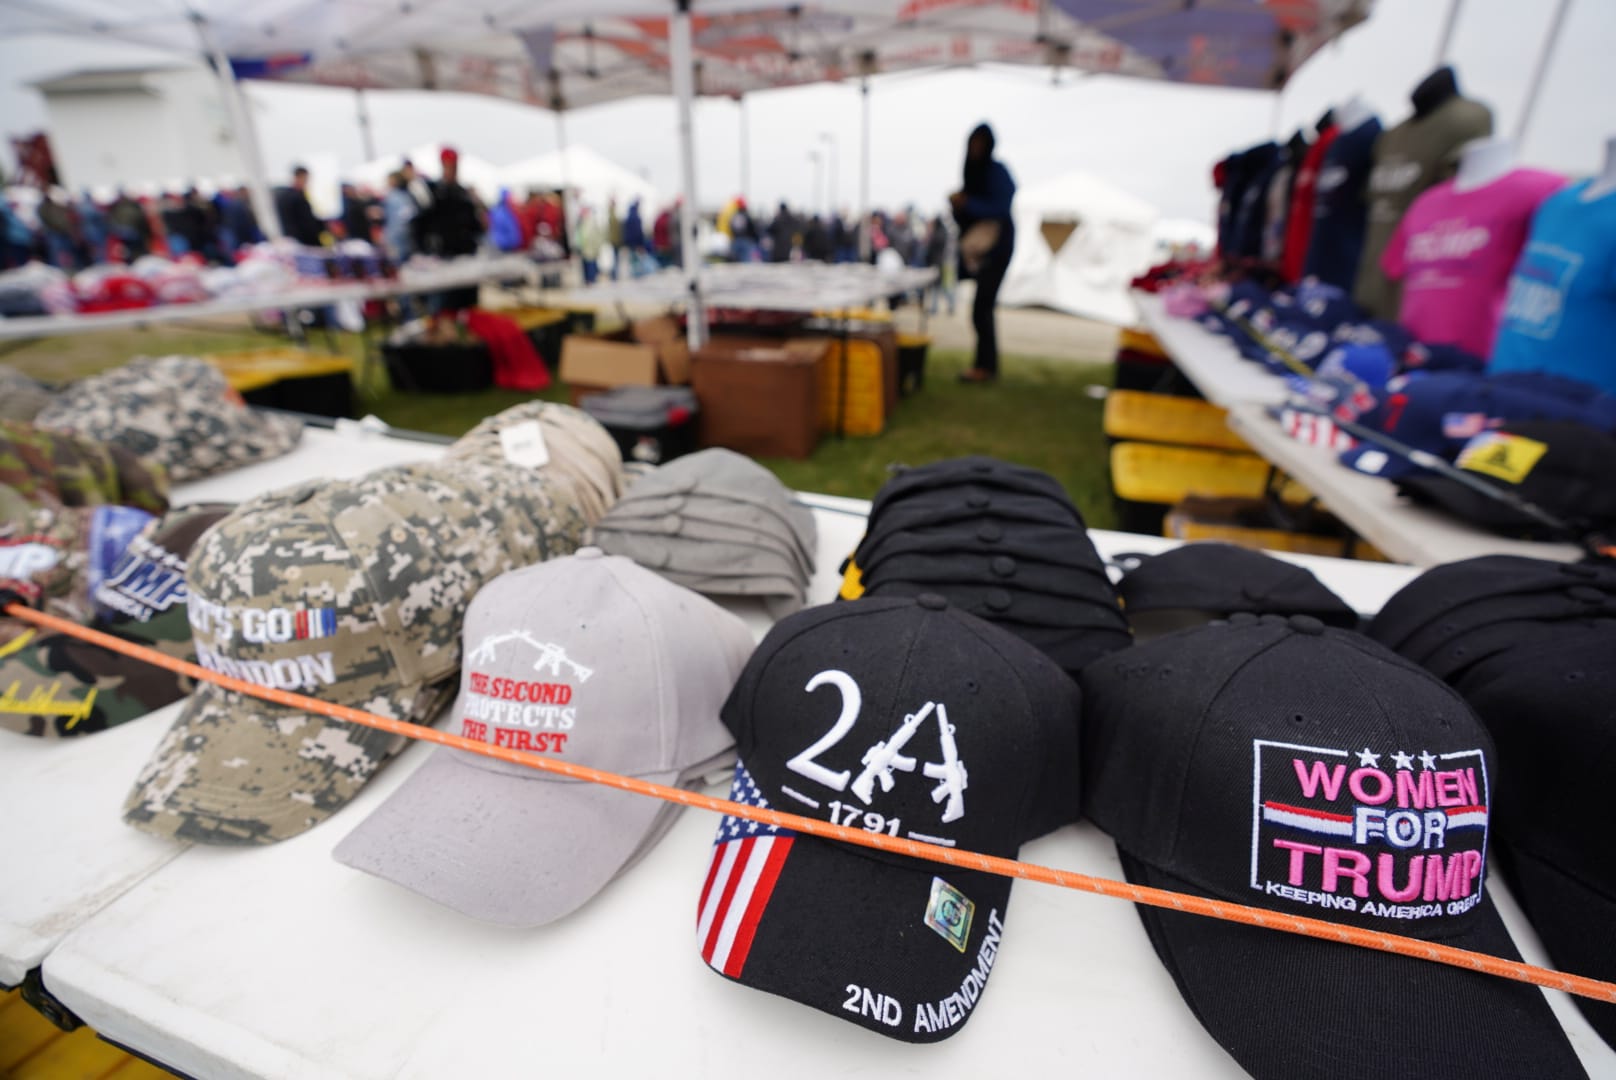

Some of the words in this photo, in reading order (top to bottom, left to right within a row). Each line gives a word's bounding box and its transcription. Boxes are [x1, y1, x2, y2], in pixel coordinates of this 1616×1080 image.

[242, 607, 293, 643] GO
[469, 672, 490, 696] THE
[490, 677, 572, 705] SECOND
[461, 718, 488, 743] THE
[493, 727, 568, 753] FIRST
[1292, 758, 1480, 809] WOMEN
[828, 800, 901, 838] 1791
[1353, 805, 1448, 850] FOR
[1273, 838, 1482, 903] TRUMP
[1266, 880, 1357, 911] KEEPING
[1360, 901, 1443, 920] AMERICA
[842, 983, 903, 1027] 2ND
[913, 907, 1004, 1034] AMENDMENT
